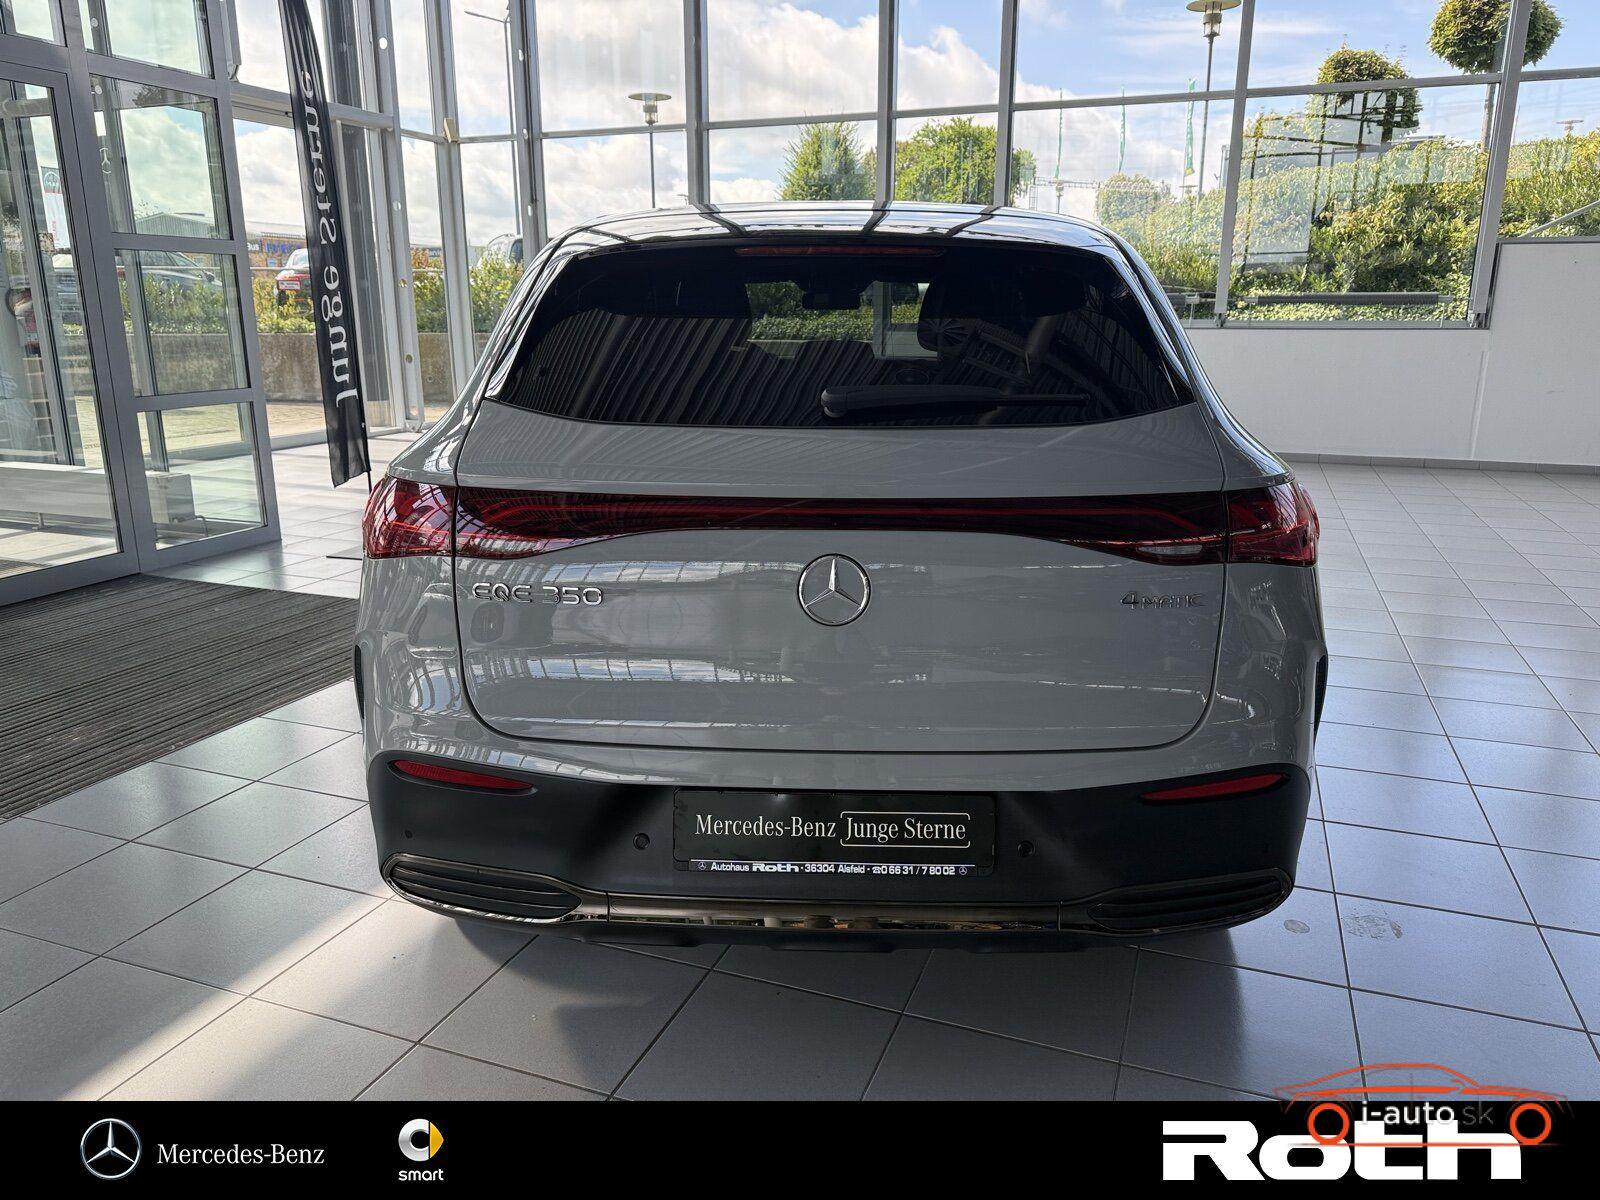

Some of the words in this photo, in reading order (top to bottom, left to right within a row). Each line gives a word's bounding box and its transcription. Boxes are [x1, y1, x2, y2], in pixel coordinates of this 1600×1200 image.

[472, 582, 532, 603] EQE
[542, 586, 603, 606] 350
[695, 814, 836, 838] Mercedes-Benz
[845, 817, 899, 843] Junge
[904, 818, 966, 840] Sterne
[711, 862, 750, 872] Autohaus
[752, 863, 799, 873] Roth
[804, 864, 835, 873] 36304
[838, 864, 865, 874] Alsfeld
